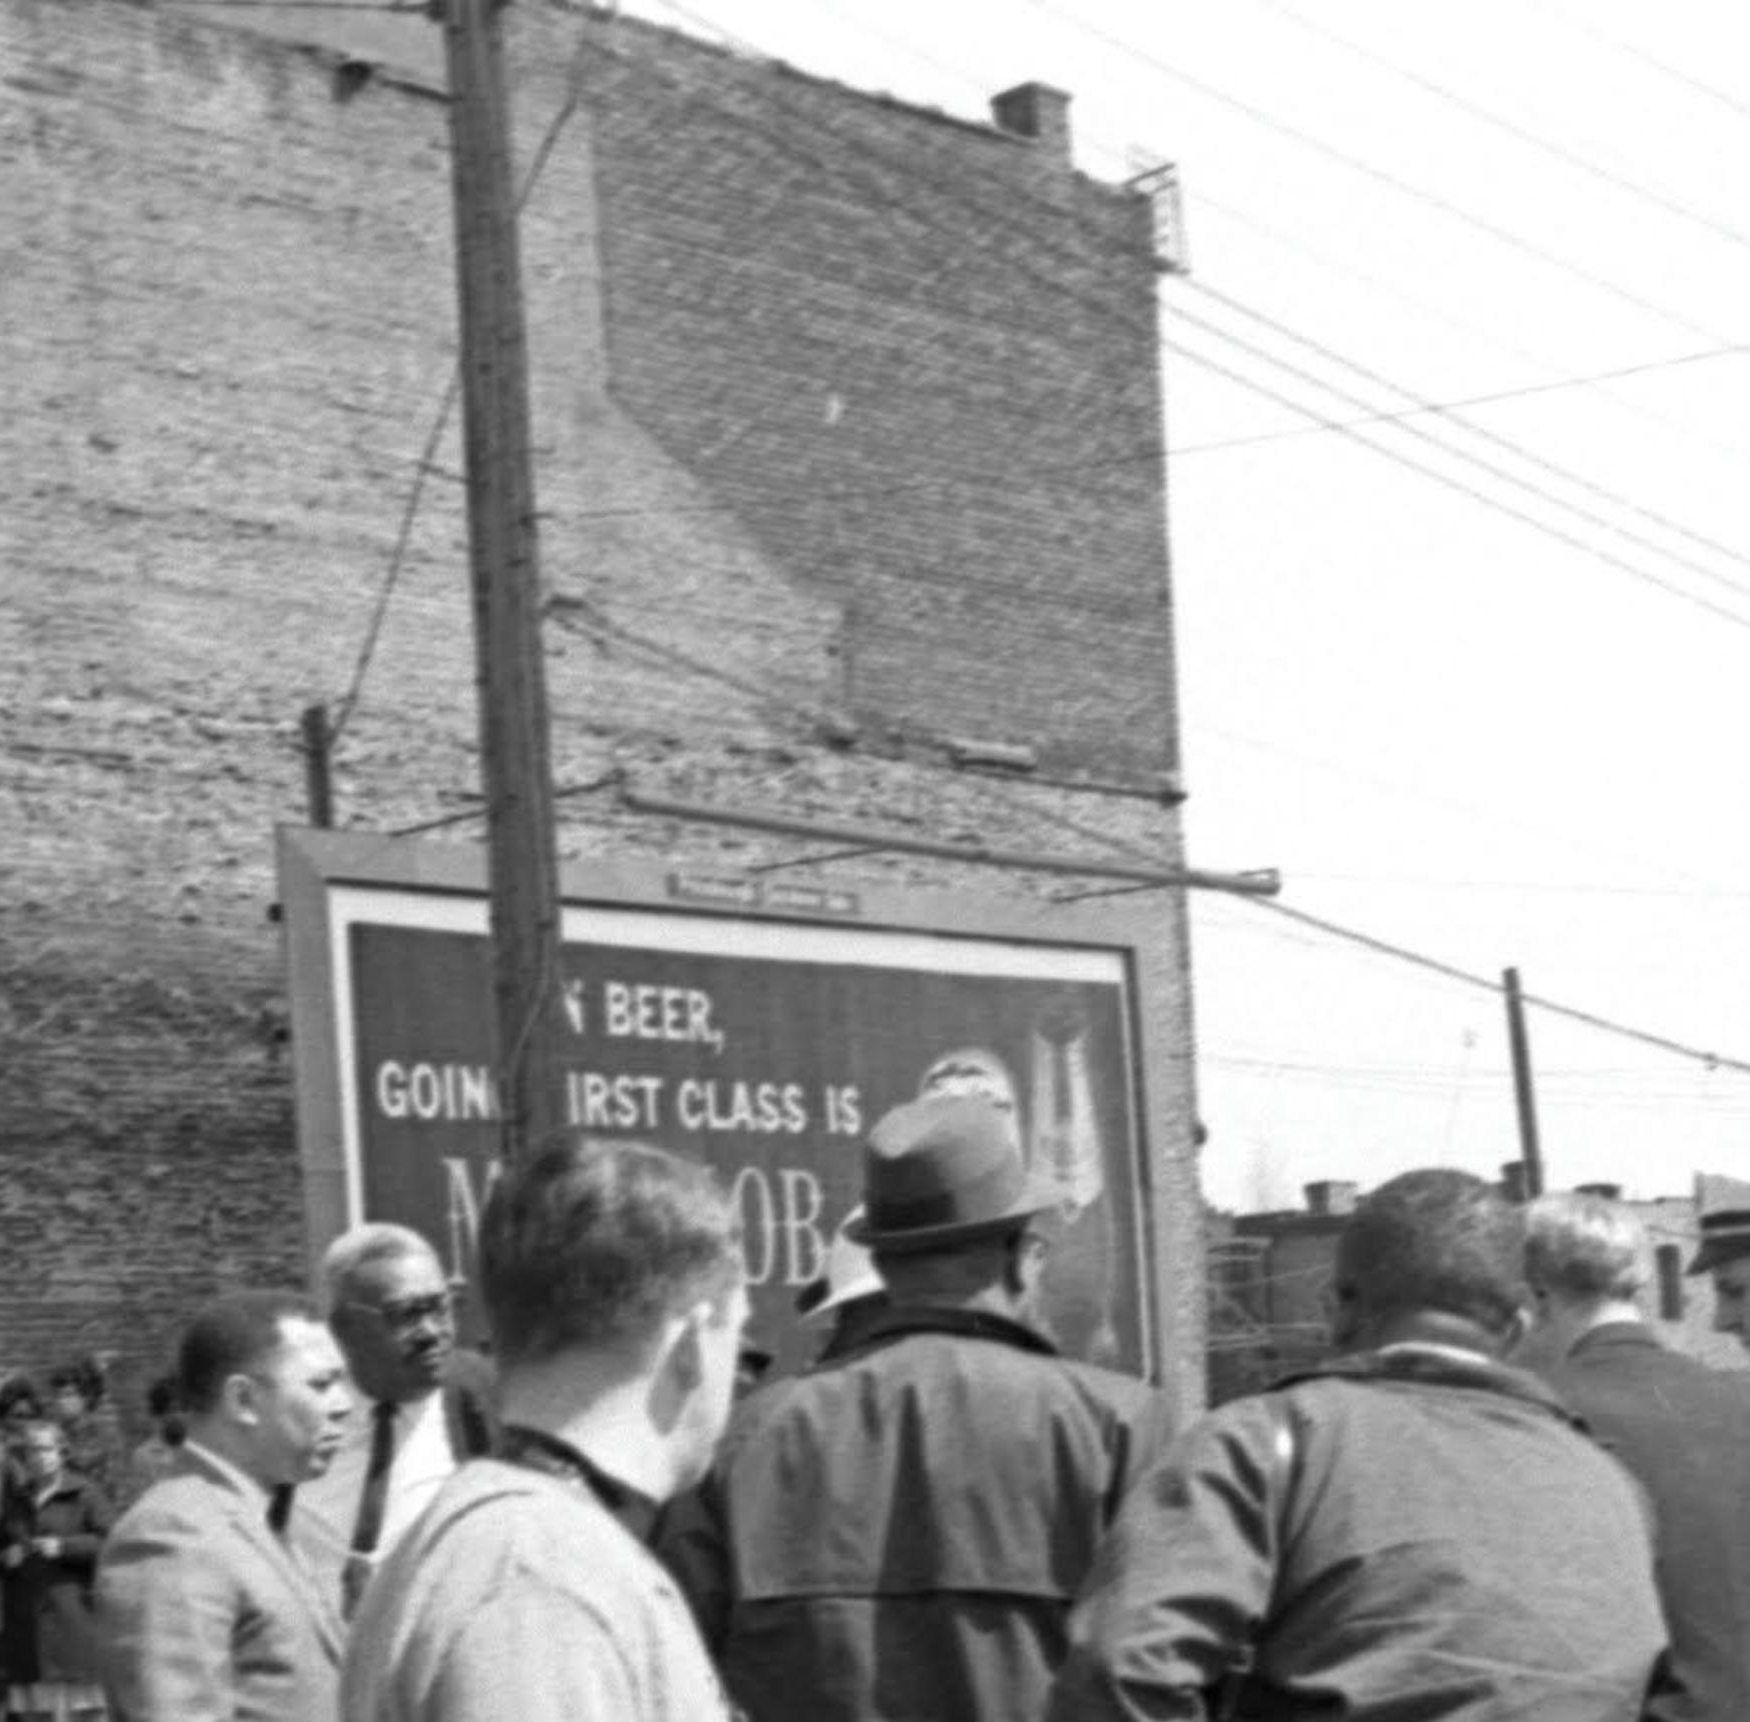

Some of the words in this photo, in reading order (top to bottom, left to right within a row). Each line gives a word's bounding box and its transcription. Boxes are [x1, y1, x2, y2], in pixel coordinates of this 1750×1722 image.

[605, 981, 724, 1055] BEER,
[376, 1059, 500, 1121] GOIN
[566, 1069, 664, 1128] IRST
[678, 1078, 807, 1134] CLASS
[825, 1083, 862, 1136] IS
